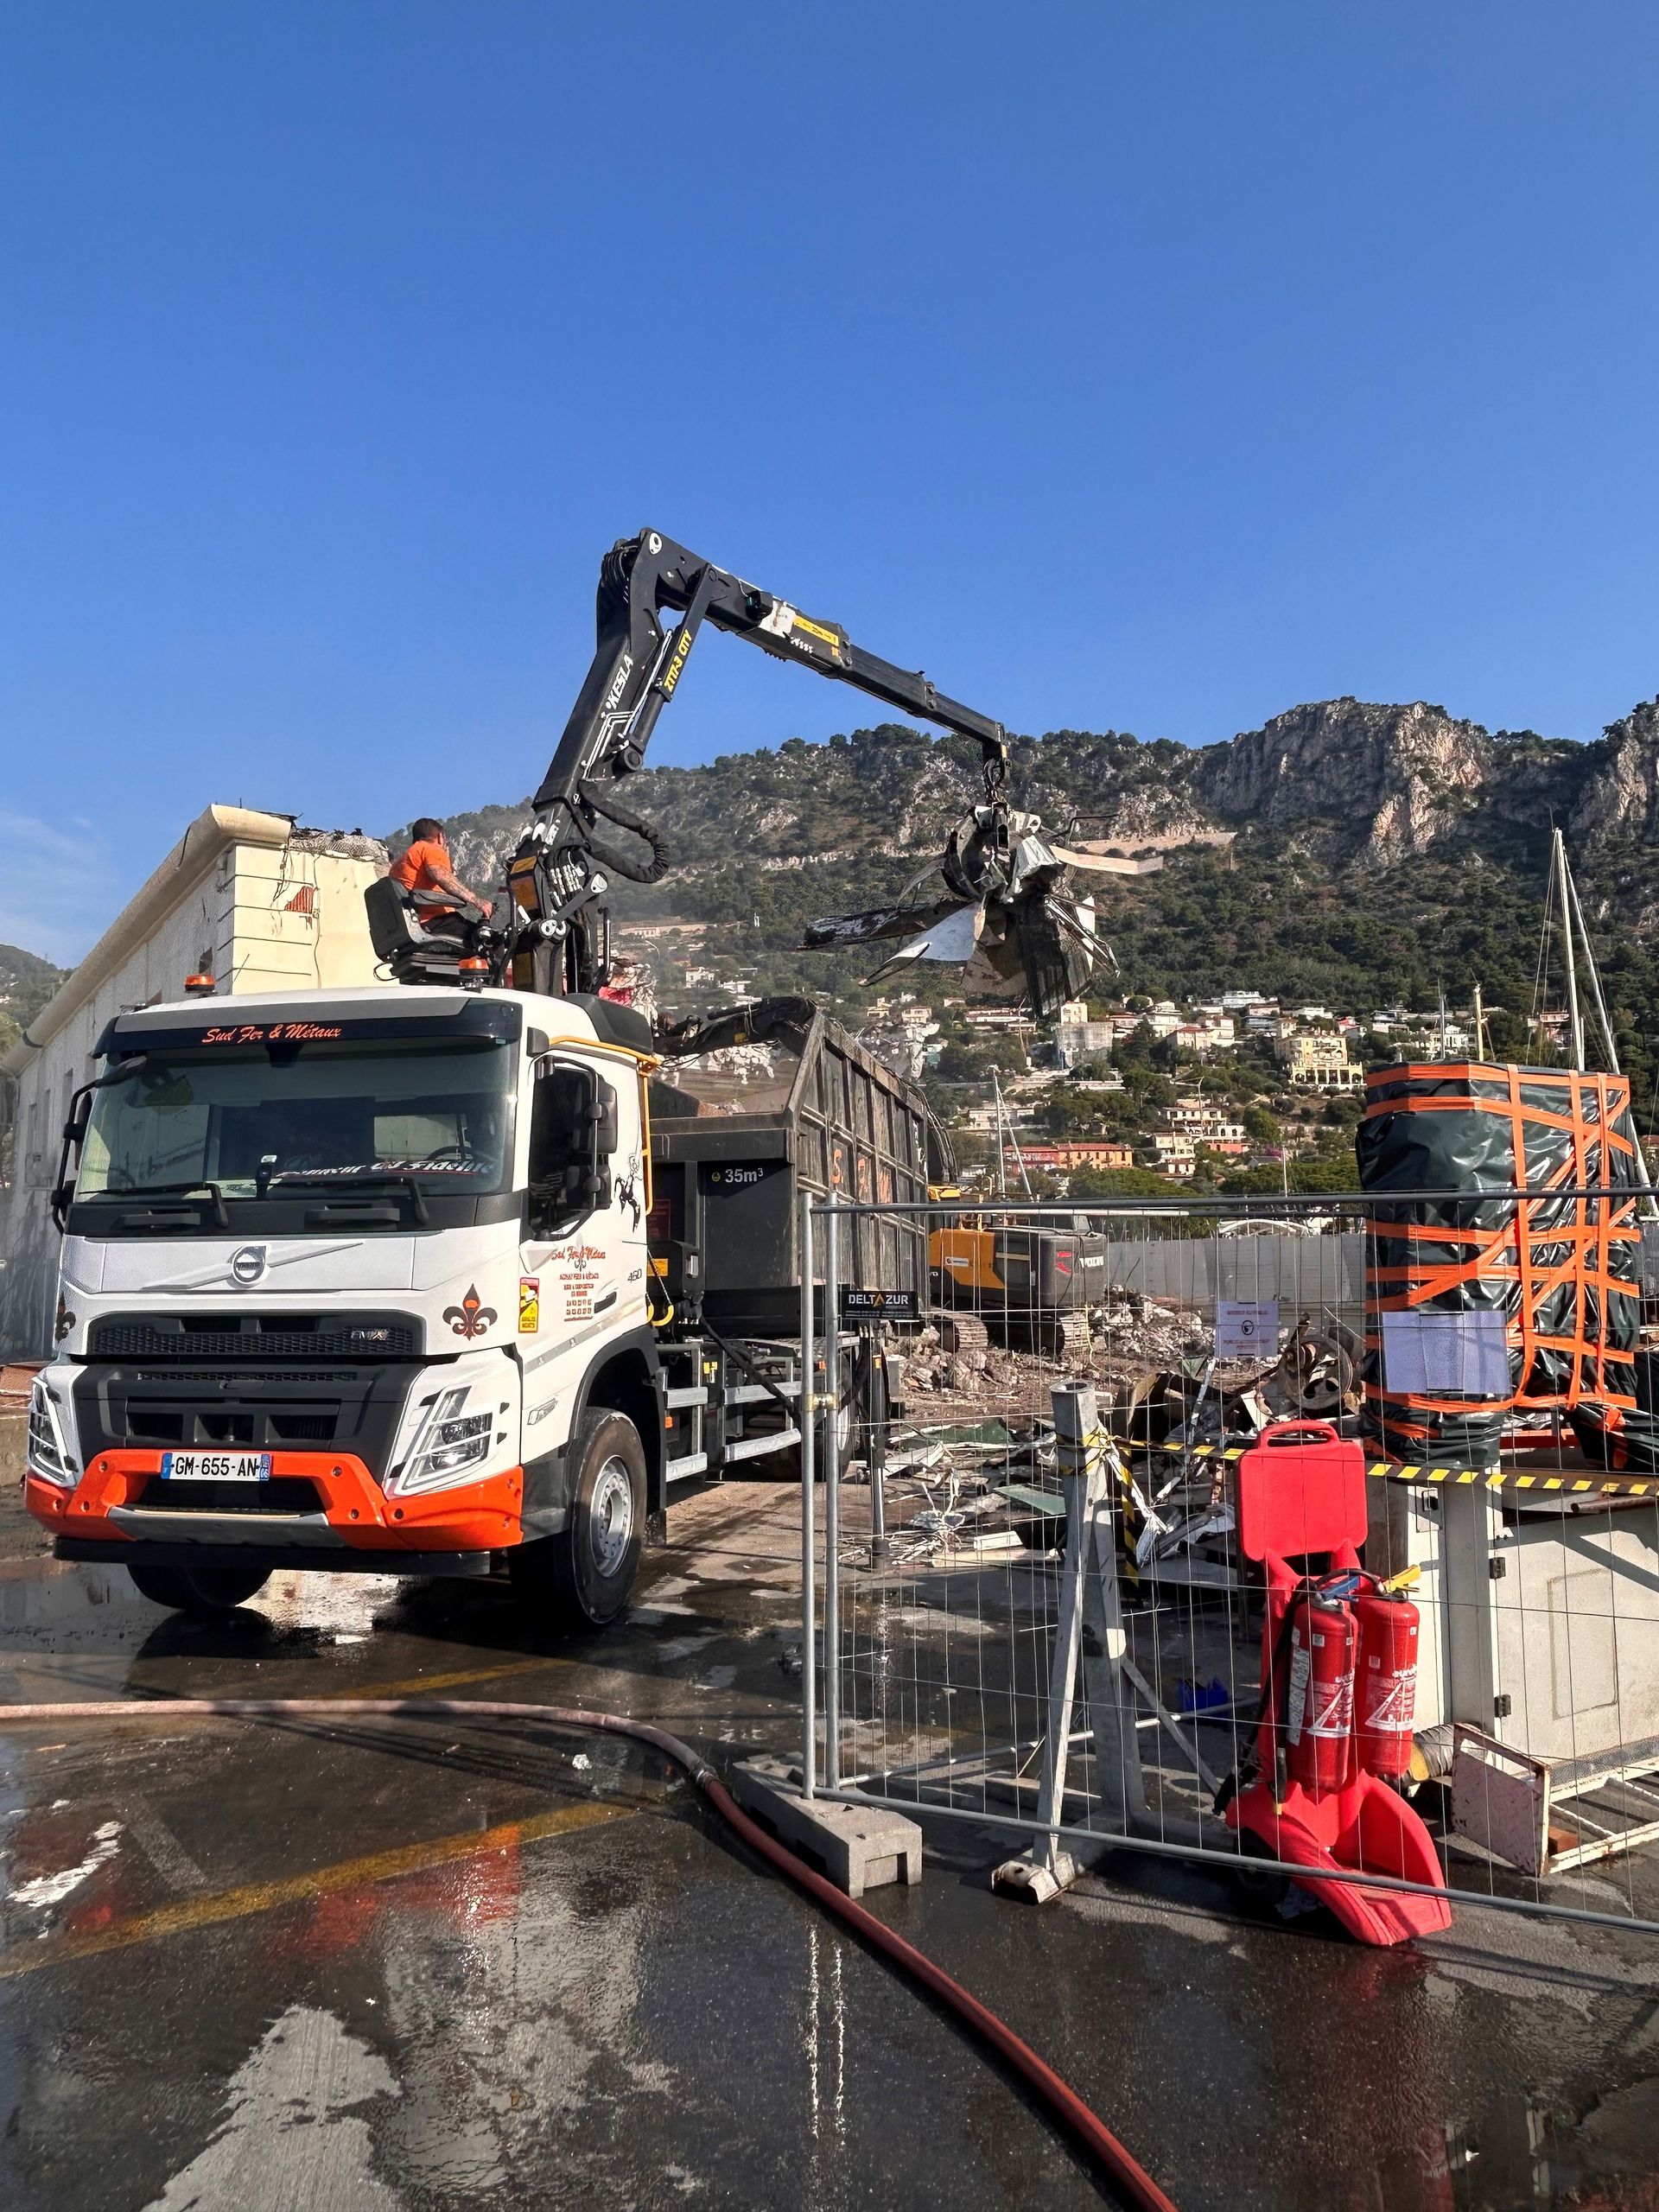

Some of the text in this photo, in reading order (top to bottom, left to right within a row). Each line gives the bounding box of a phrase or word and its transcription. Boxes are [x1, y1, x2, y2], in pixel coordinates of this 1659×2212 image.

[607, 654, 633, 709] KESLA
[201, 1023, 342, 1044] Sud Fer & Métaux
[175, 1457, 257, 1476] GM-655-AN
